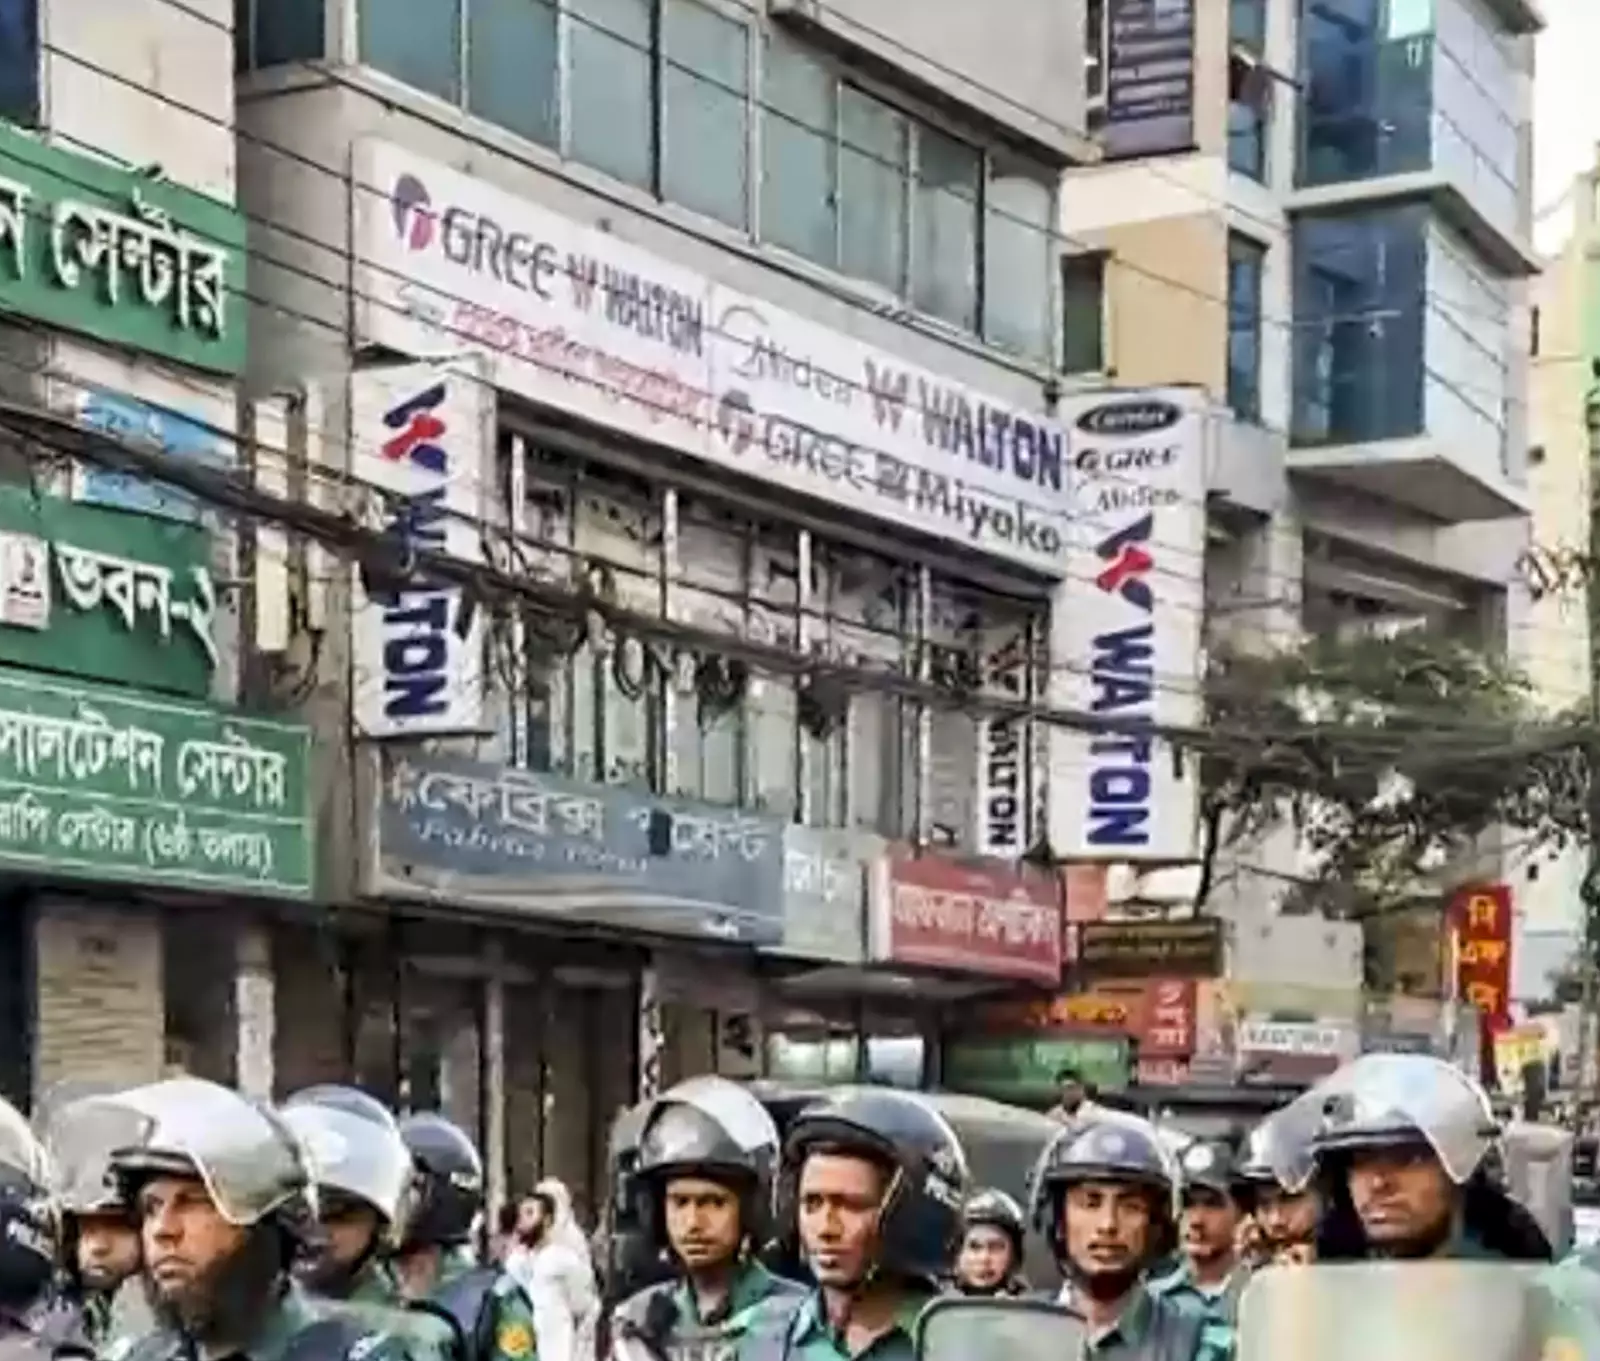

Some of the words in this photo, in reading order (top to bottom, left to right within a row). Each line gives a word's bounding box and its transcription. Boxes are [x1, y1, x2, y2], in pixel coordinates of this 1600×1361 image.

[51, 187, 230, 339] সেন্টার
[916, 376, 1063, 493] WALTON
[176, 729, 288, 807] সেন্টার
